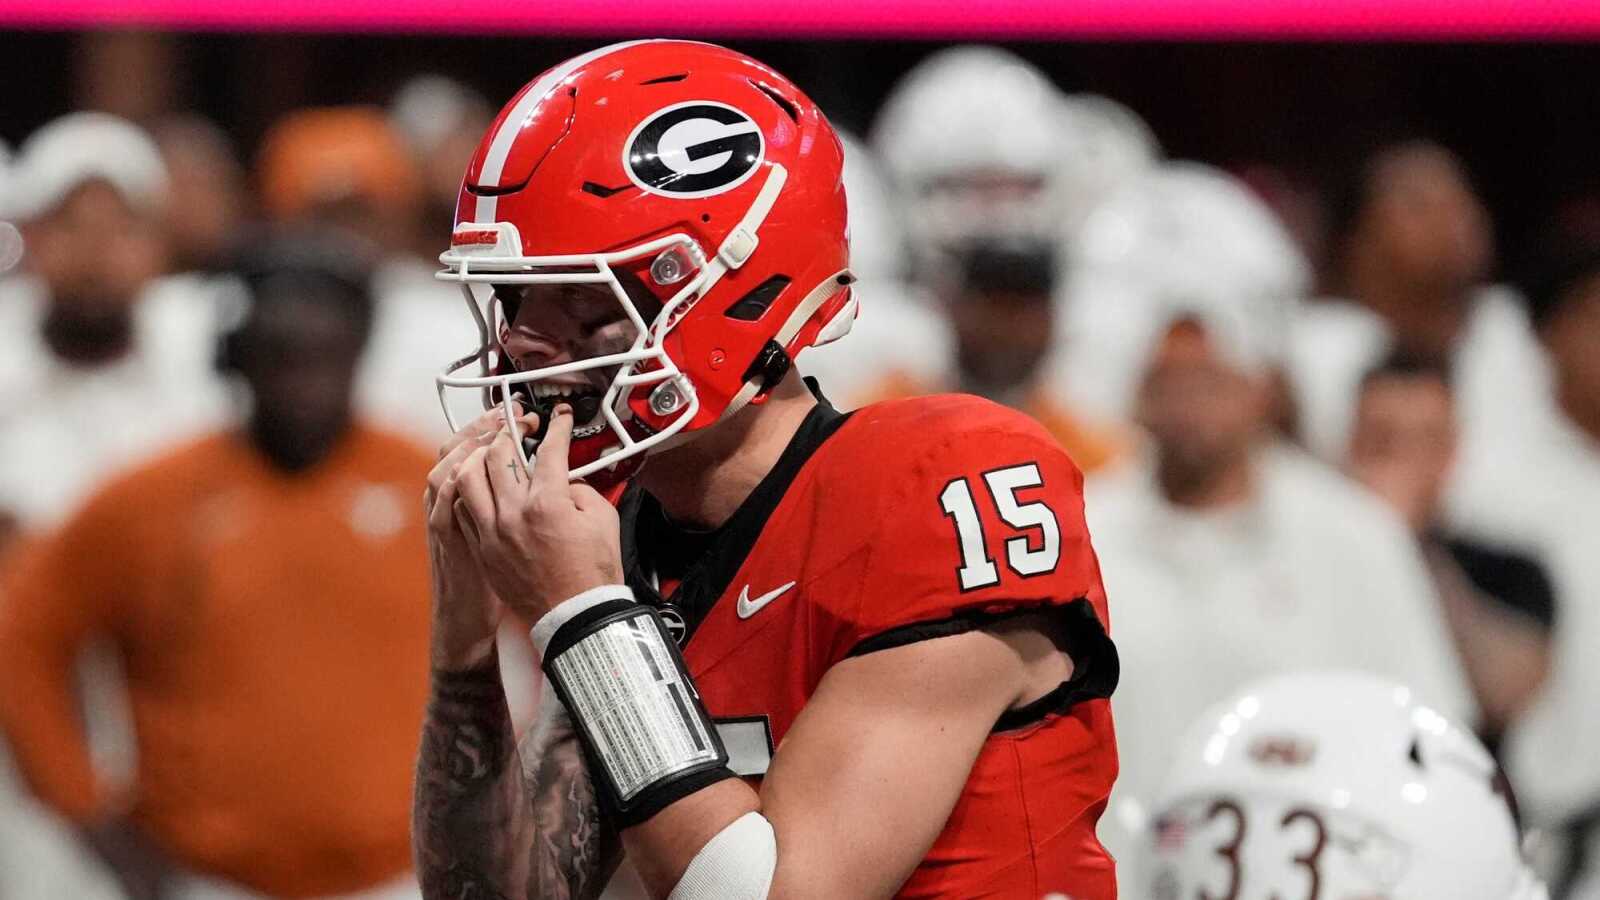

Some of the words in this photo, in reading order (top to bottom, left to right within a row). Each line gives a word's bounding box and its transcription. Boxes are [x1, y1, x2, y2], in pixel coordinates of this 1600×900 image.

[628, 104, 761, 193] G
[937, 461, 1062, 593] 15
[1199, 799, 1328, 900] 33
